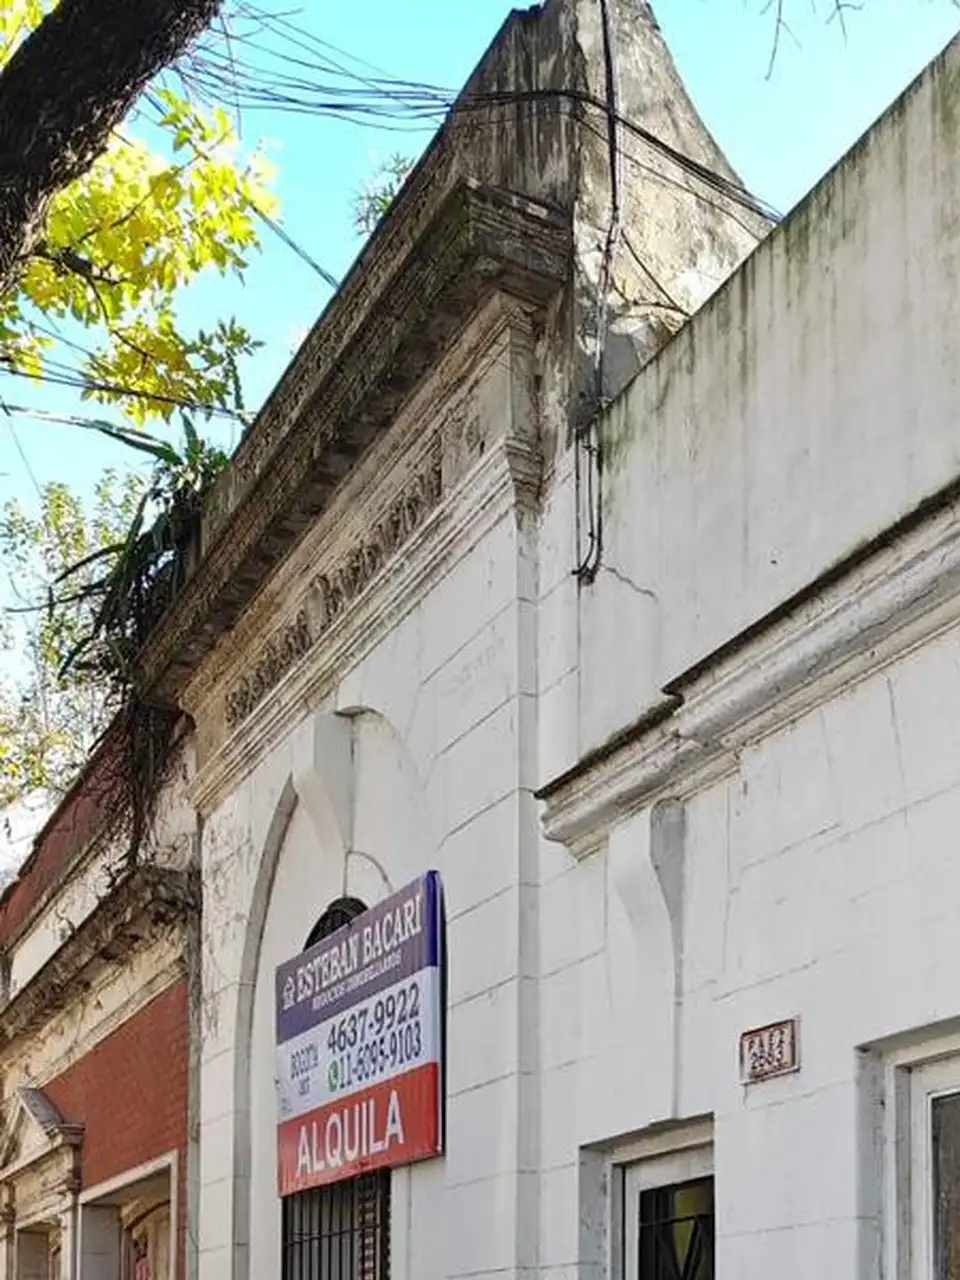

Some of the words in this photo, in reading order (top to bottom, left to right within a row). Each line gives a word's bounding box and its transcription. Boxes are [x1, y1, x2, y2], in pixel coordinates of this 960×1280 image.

[297, 933, 359, 1001] ESTEBAN
[363, 893, 421, 963] BACARI
[327, 982, 420, 1056] 4637-9922
[296, 1090, 404, 1175] ALQUILA
